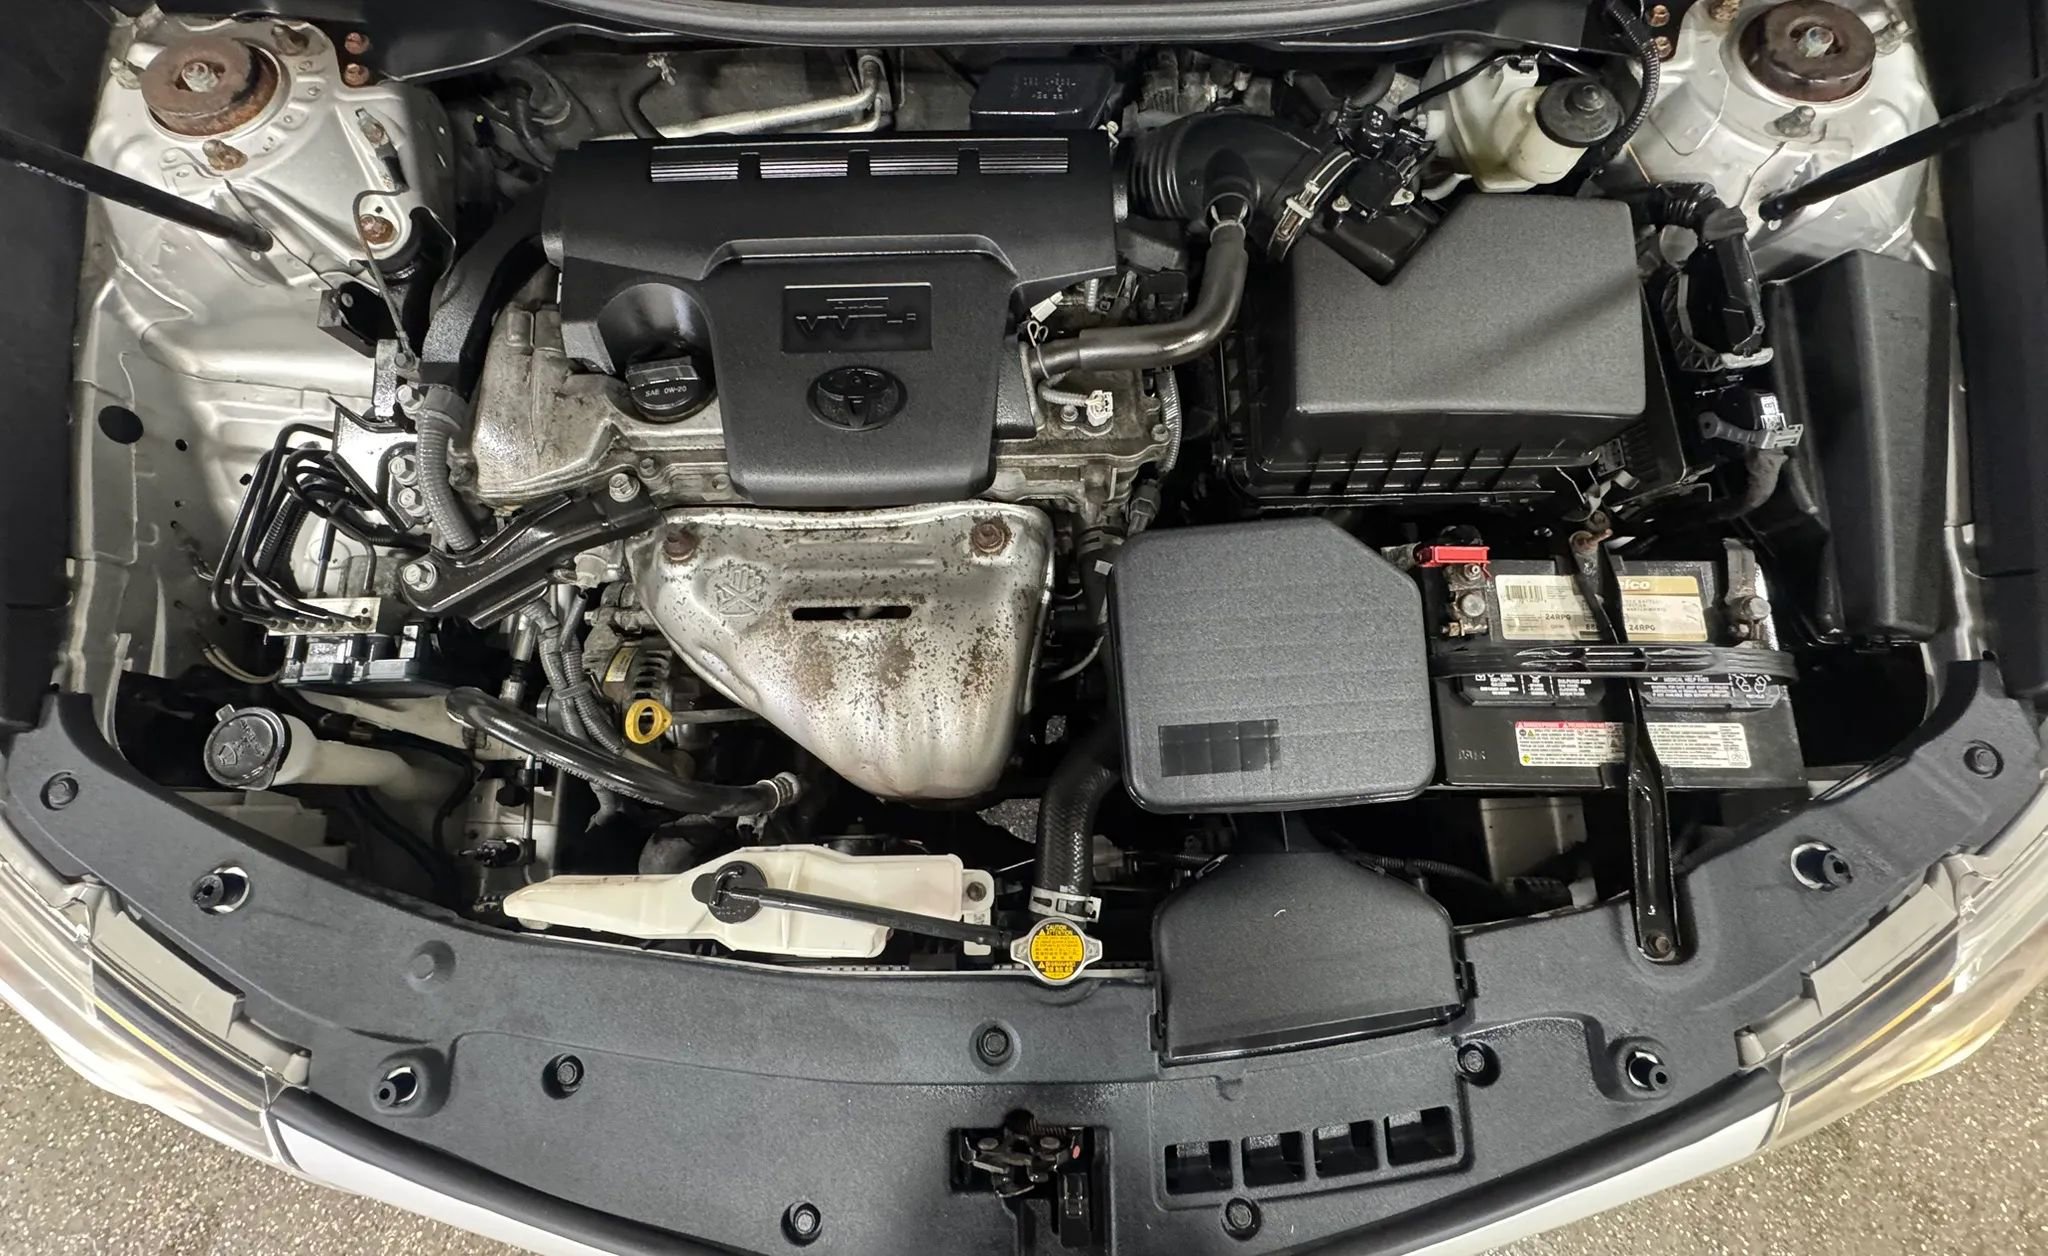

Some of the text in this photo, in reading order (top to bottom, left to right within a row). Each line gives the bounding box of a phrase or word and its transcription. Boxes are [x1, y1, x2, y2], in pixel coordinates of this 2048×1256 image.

[645, 385, 688, 398] SAE 0W-20
[1545, 613, 1571, 621] 24RPG
